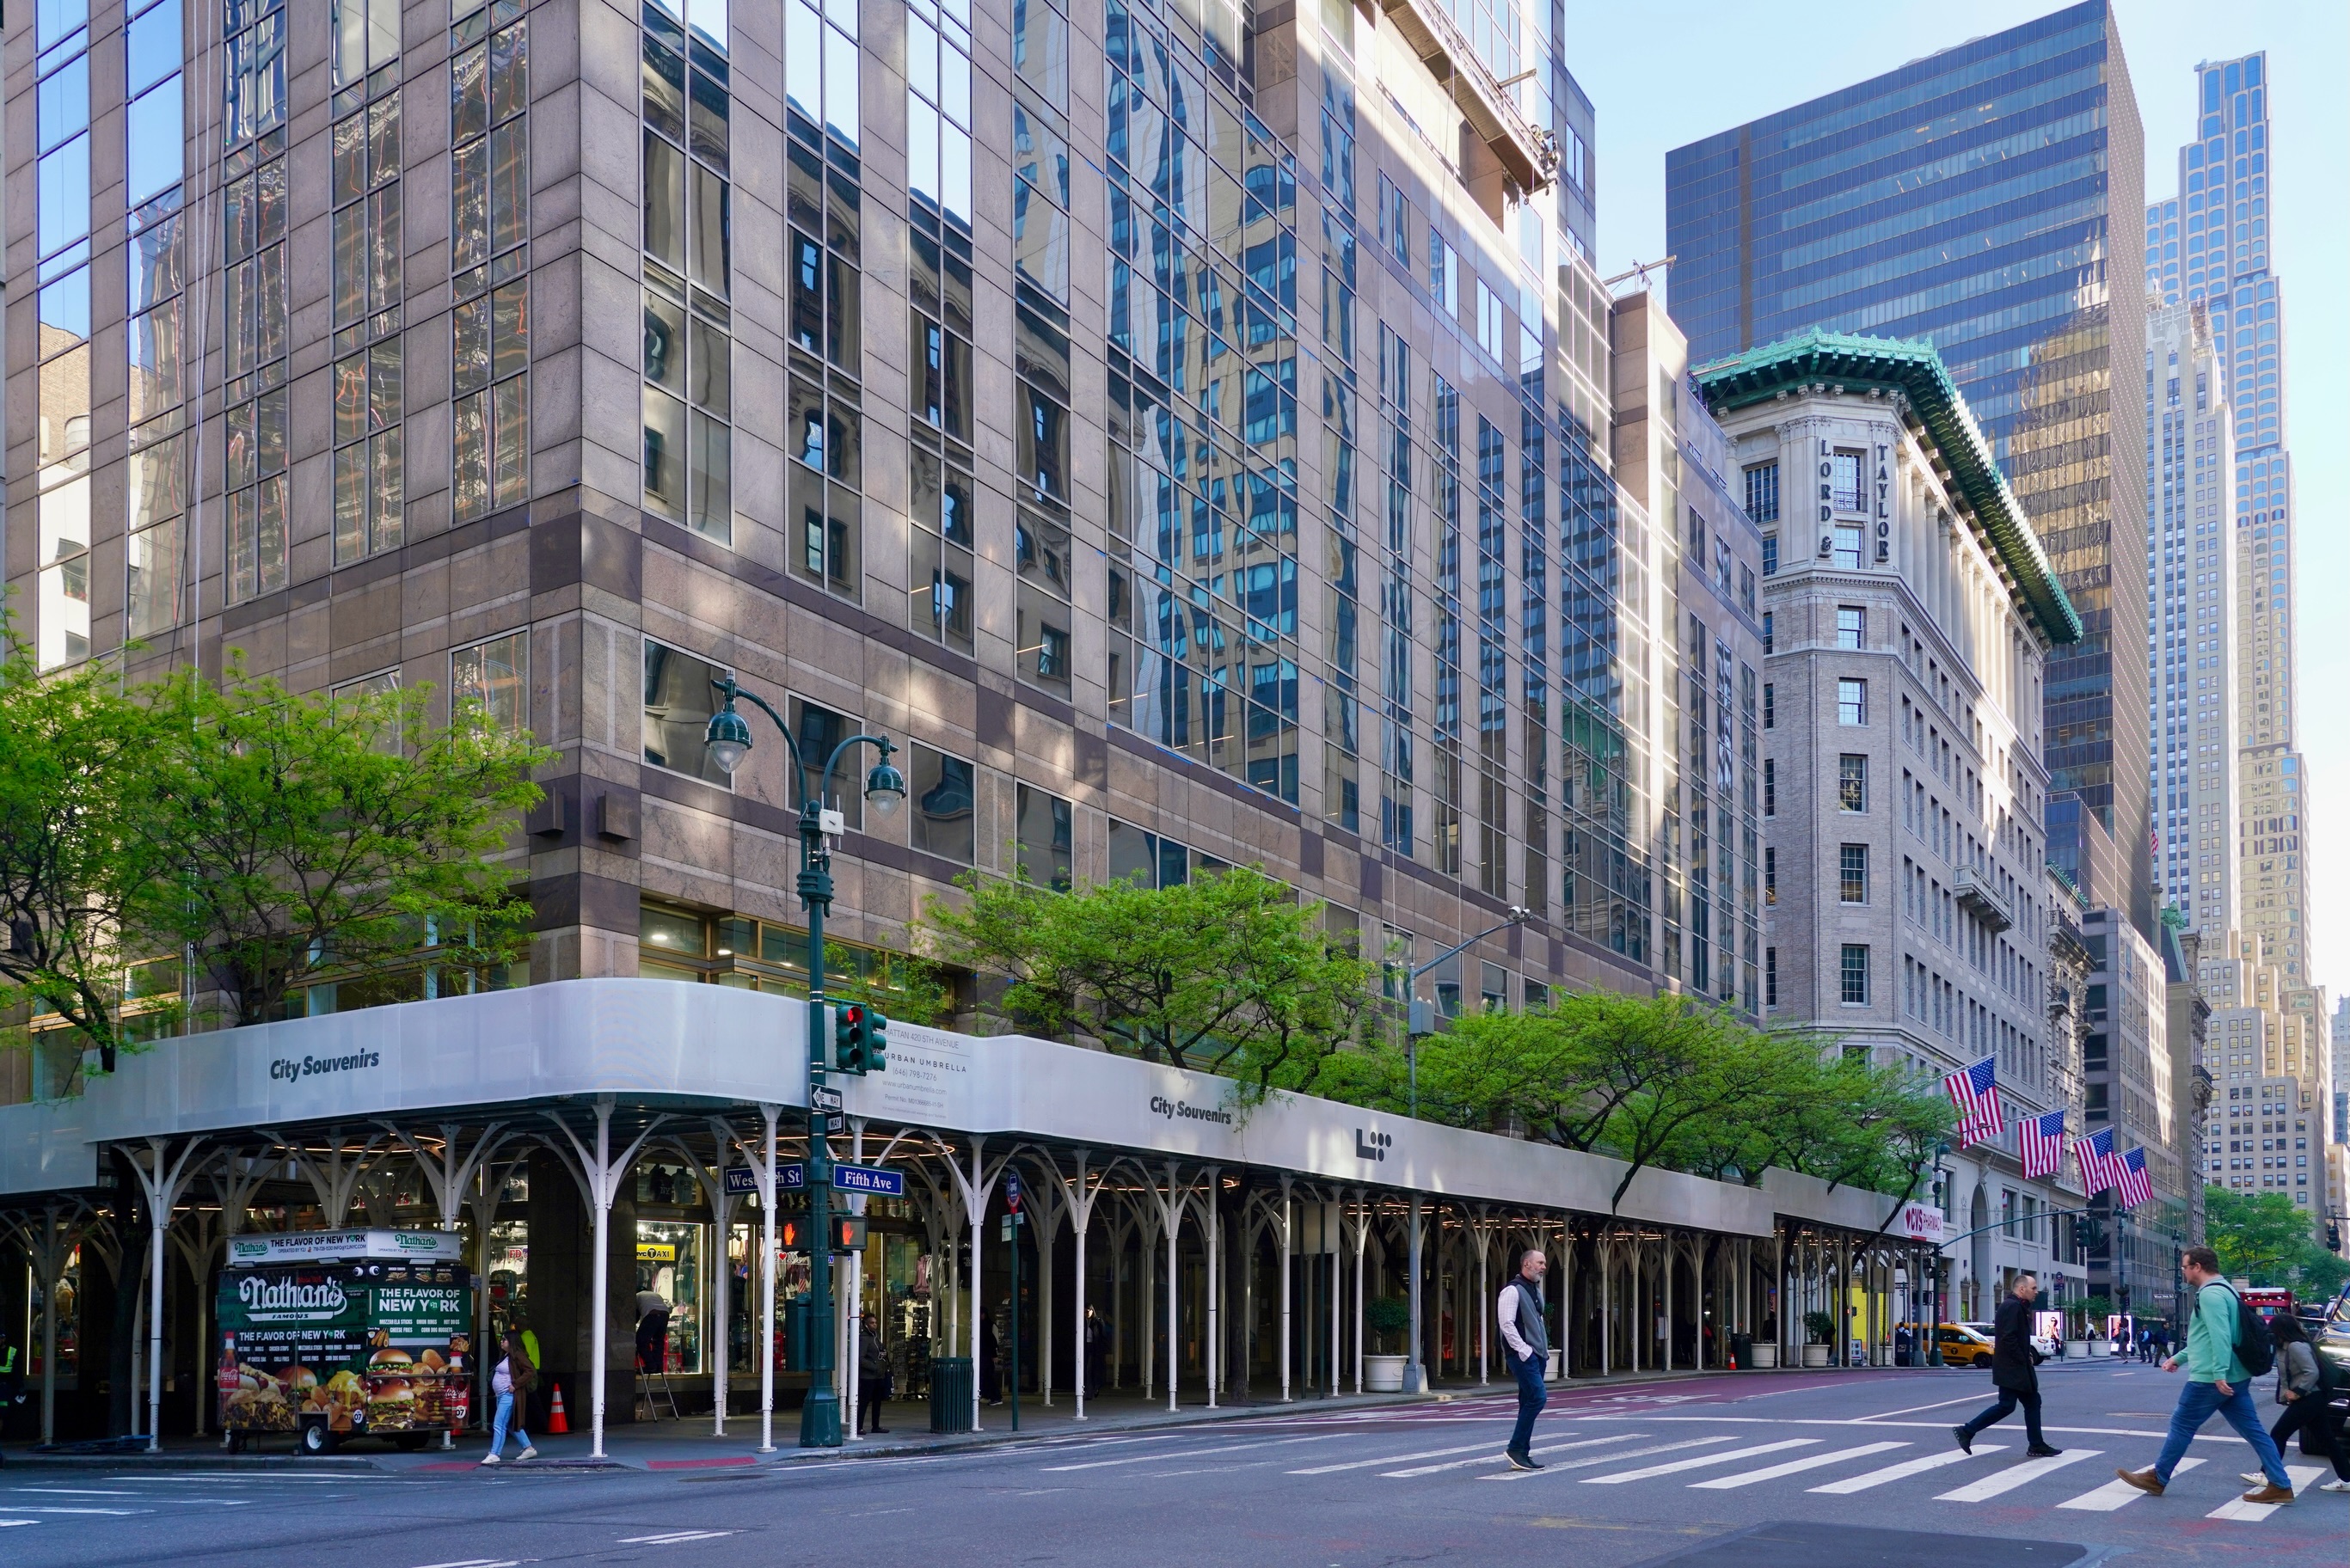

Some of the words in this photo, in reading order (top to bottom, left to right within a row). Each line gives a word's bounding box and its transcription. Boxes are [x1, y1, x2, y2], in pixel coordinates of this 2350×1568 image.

[1820, 438, 1832, 522] LORD
[1877, 443, 1889, 557] TAYLOR
[922, 1035, 935, 1044] 5TH
[935, 1038, 960, 1049] AVENUE
[270, 1058, 301, 1083] City
[303, 1047, 379, 1075] Souvenirs
[884, 1052, 916, 1064] URBAN
[919, 1058, 966, 1073] UMBRELLA
[893, 1067, 908, 1078] (646)
[882, 1080, 948, 1095] www.urbanumbrella.com
[816, 1092, 825, 1103] ONE
[830, 1095, 840, 1106] WAY
[1150, 1096, 1175, 1120] City
[1176, 1100, 1231, 1124] Souvenirs
[829, 1118, 841, 1129] WAY
[788, 1170, 801, 1184] St
[844, 1171, 870, 1186] Fifth
[872, 1174, 892, 1190] Ave
[1911, 1207, 1924, 1232] CVS
[1924, 1213, 1942, 1232] PHARMACY
[270, 1239, 284, 1247] THE
[286, 1237, 313, 1246] FLAVOR
[315, 1236, 325, 1245] OF
[327, 1235, 344, 1244] NEW
[395, 1234, 439, 1246] Nathan's
[239, 1276, 347, 1310] Nathan's
[379, 1288, 402, 1297] THE
[403, 1289, 444, 1298] FLAVOR
[445, 1289, 460, 1298] OF
[379, 1299, 416, 1312] NEW
[239, 1332, 255, 1341] THE
[302, 1330, 322, 1340] NEW
